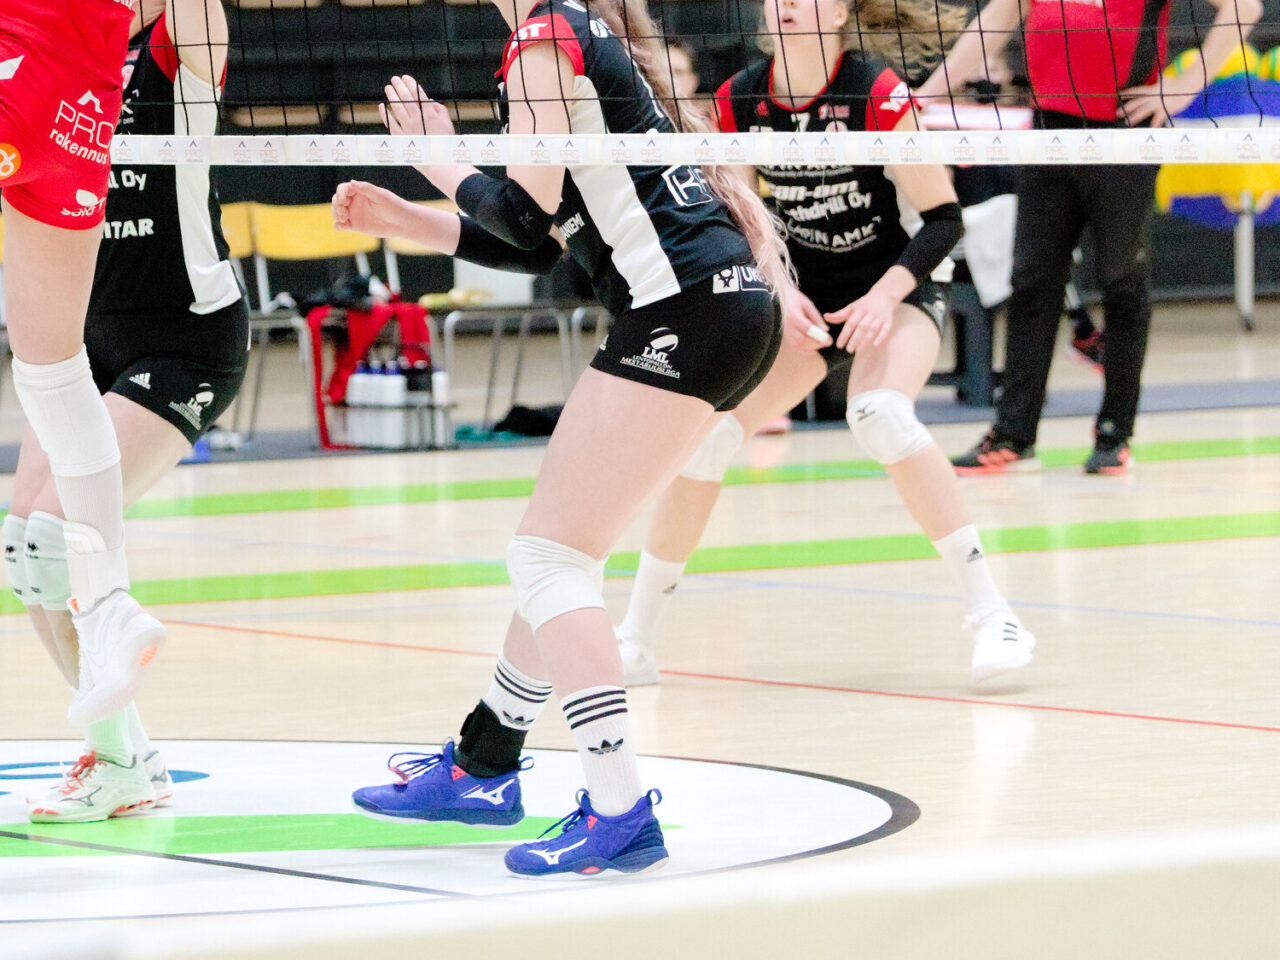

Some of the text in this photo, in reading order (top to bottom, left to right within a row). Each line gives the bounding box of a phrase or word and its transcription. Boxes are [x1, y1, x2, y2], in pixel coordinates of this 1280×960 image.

[55, 99, 114, 149] PRO
[49, 128, 108, 165] rakennus
[121, 169, 147, 191] Oy
[847, 191, 872, 210] Oy
[832, 223, 875, 248] AMK
[642, 346, 669, 364] LML
